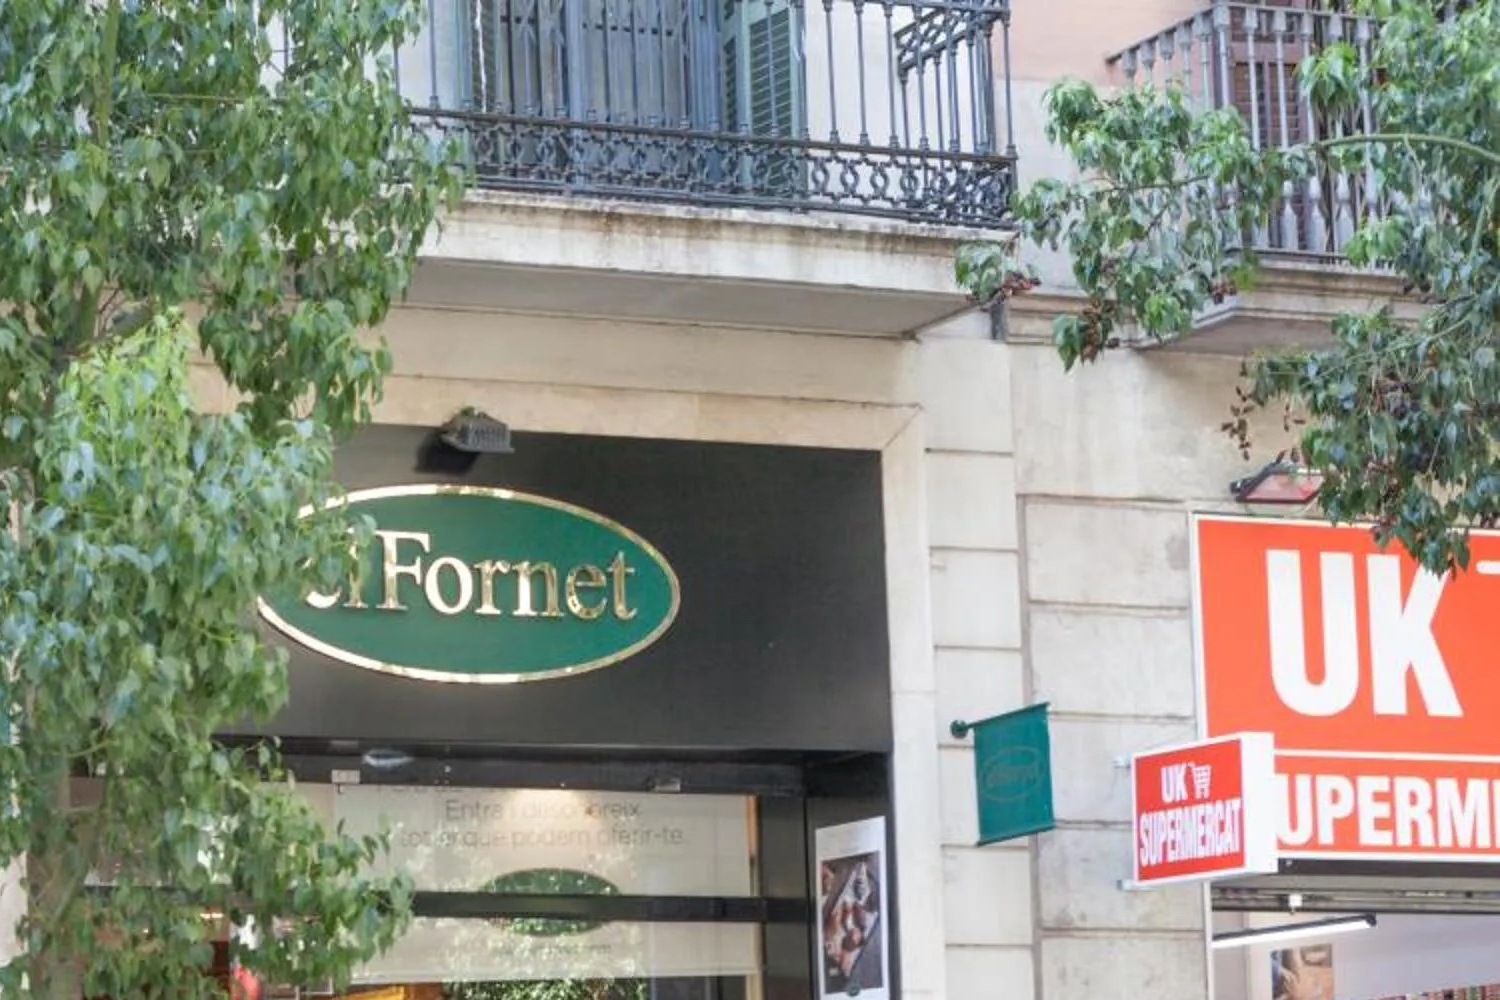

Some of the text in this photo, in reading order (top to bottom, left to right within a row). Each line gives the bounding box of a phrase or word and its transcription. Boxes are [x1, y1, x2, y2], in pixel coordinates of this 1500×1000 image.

[1266, 549, 1464, 718] UK
[446, 800, 502, 820] Entra
[1161, 762, 1189, 804] UK
[1275, 774, 1500, 849] UPERM
[1140, 798, 1242, 867] SUPERMERCAT
